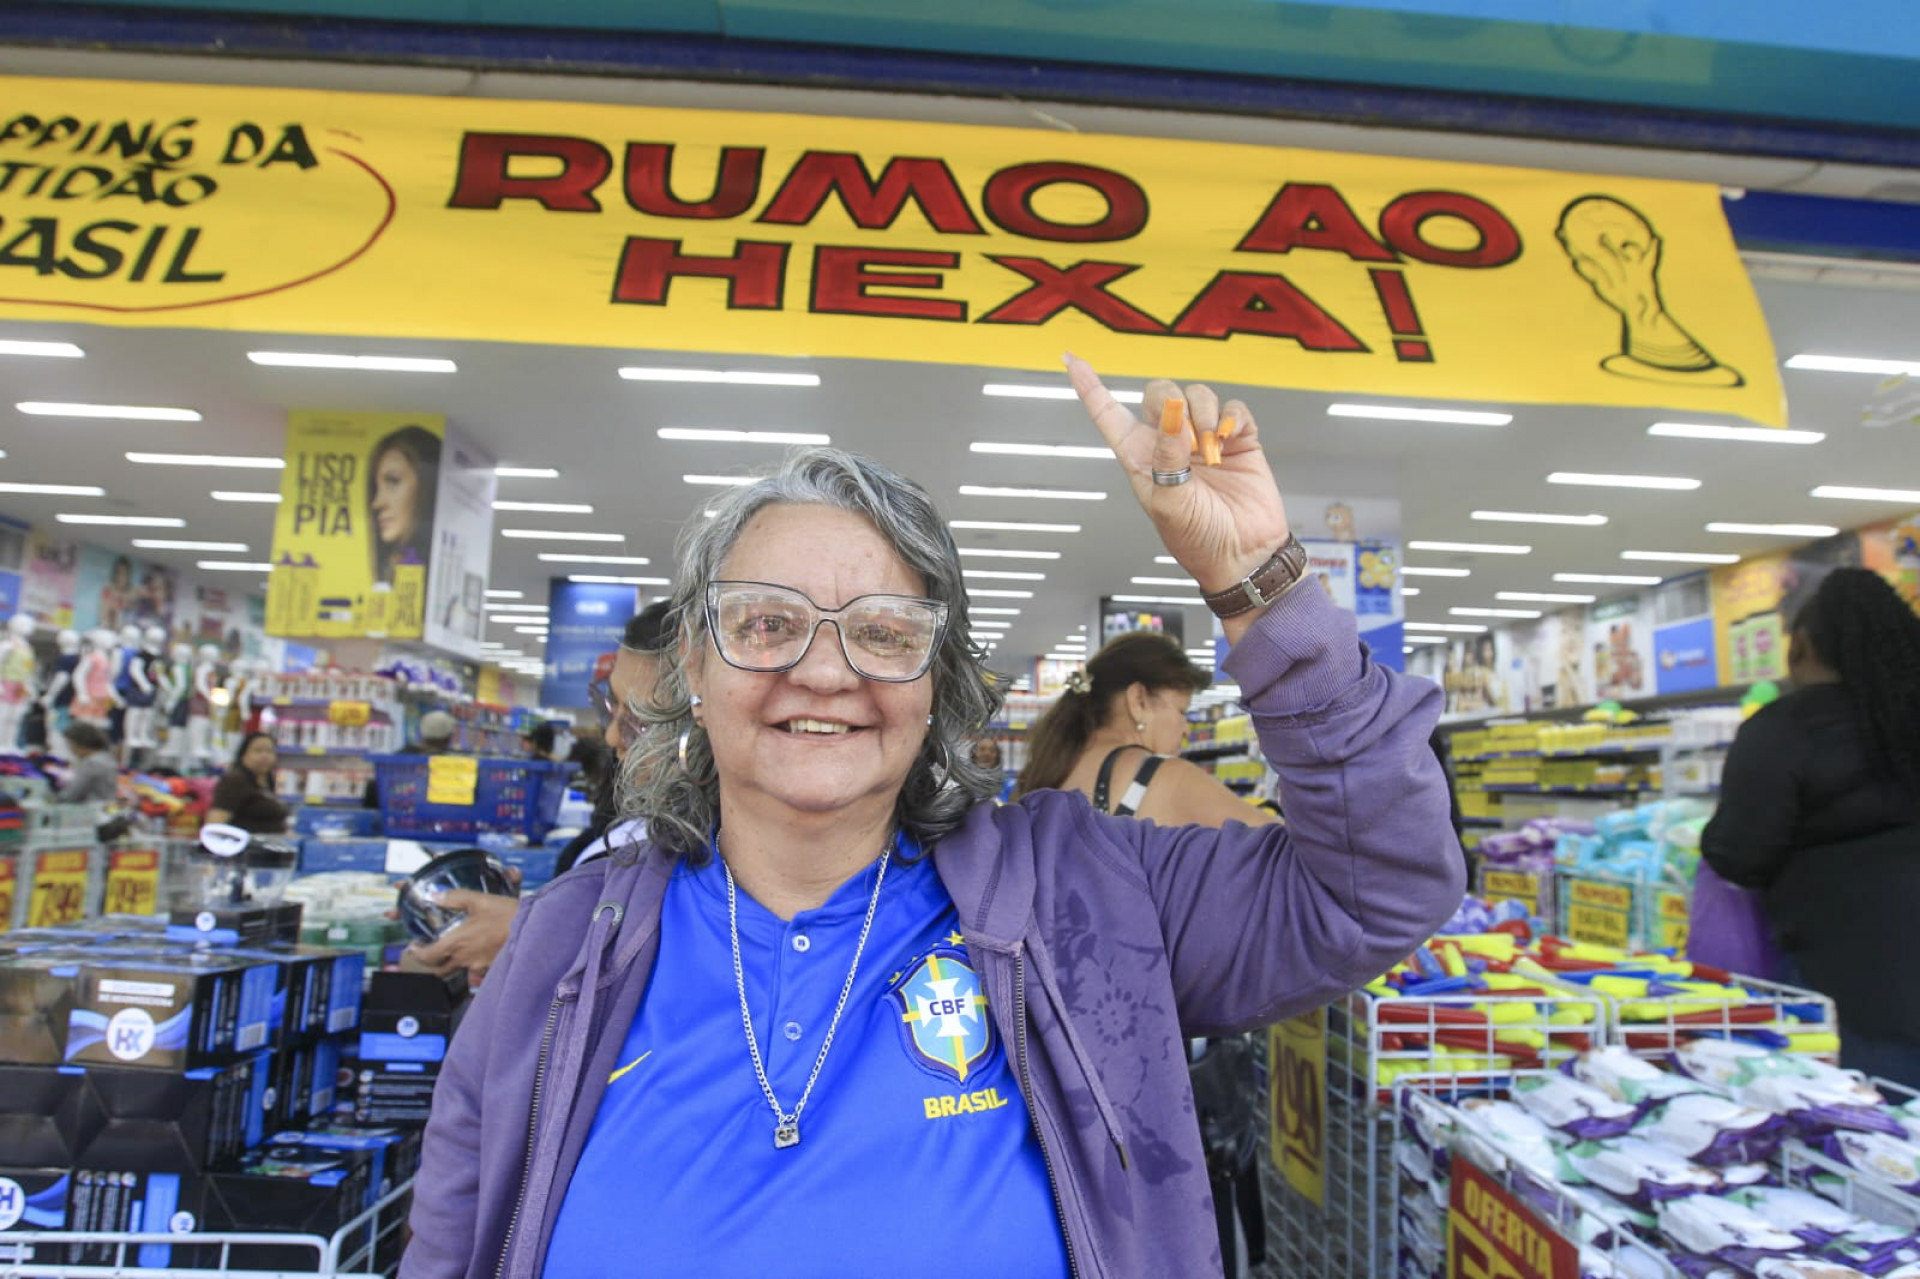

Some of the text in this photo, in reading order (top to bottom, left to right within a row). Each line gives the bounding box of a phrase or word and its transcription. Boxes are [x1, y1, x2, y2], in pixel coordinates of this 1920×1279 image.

[219, 120, 319, 169] DA
[448, 130, 1523, 270] RUMO AO
[0, 215, 227, 284] ASIL
[610, 235, 1436, 363] HEXA!
[297, 451, 357, 487] LISO
[293, 503, 354, 536] PIA
[929, 998, 967, 1017] CBF
[923, 1088, 1009, 1120] BRASIL
[1464, 1178, 1553, 1279] OFERTA
